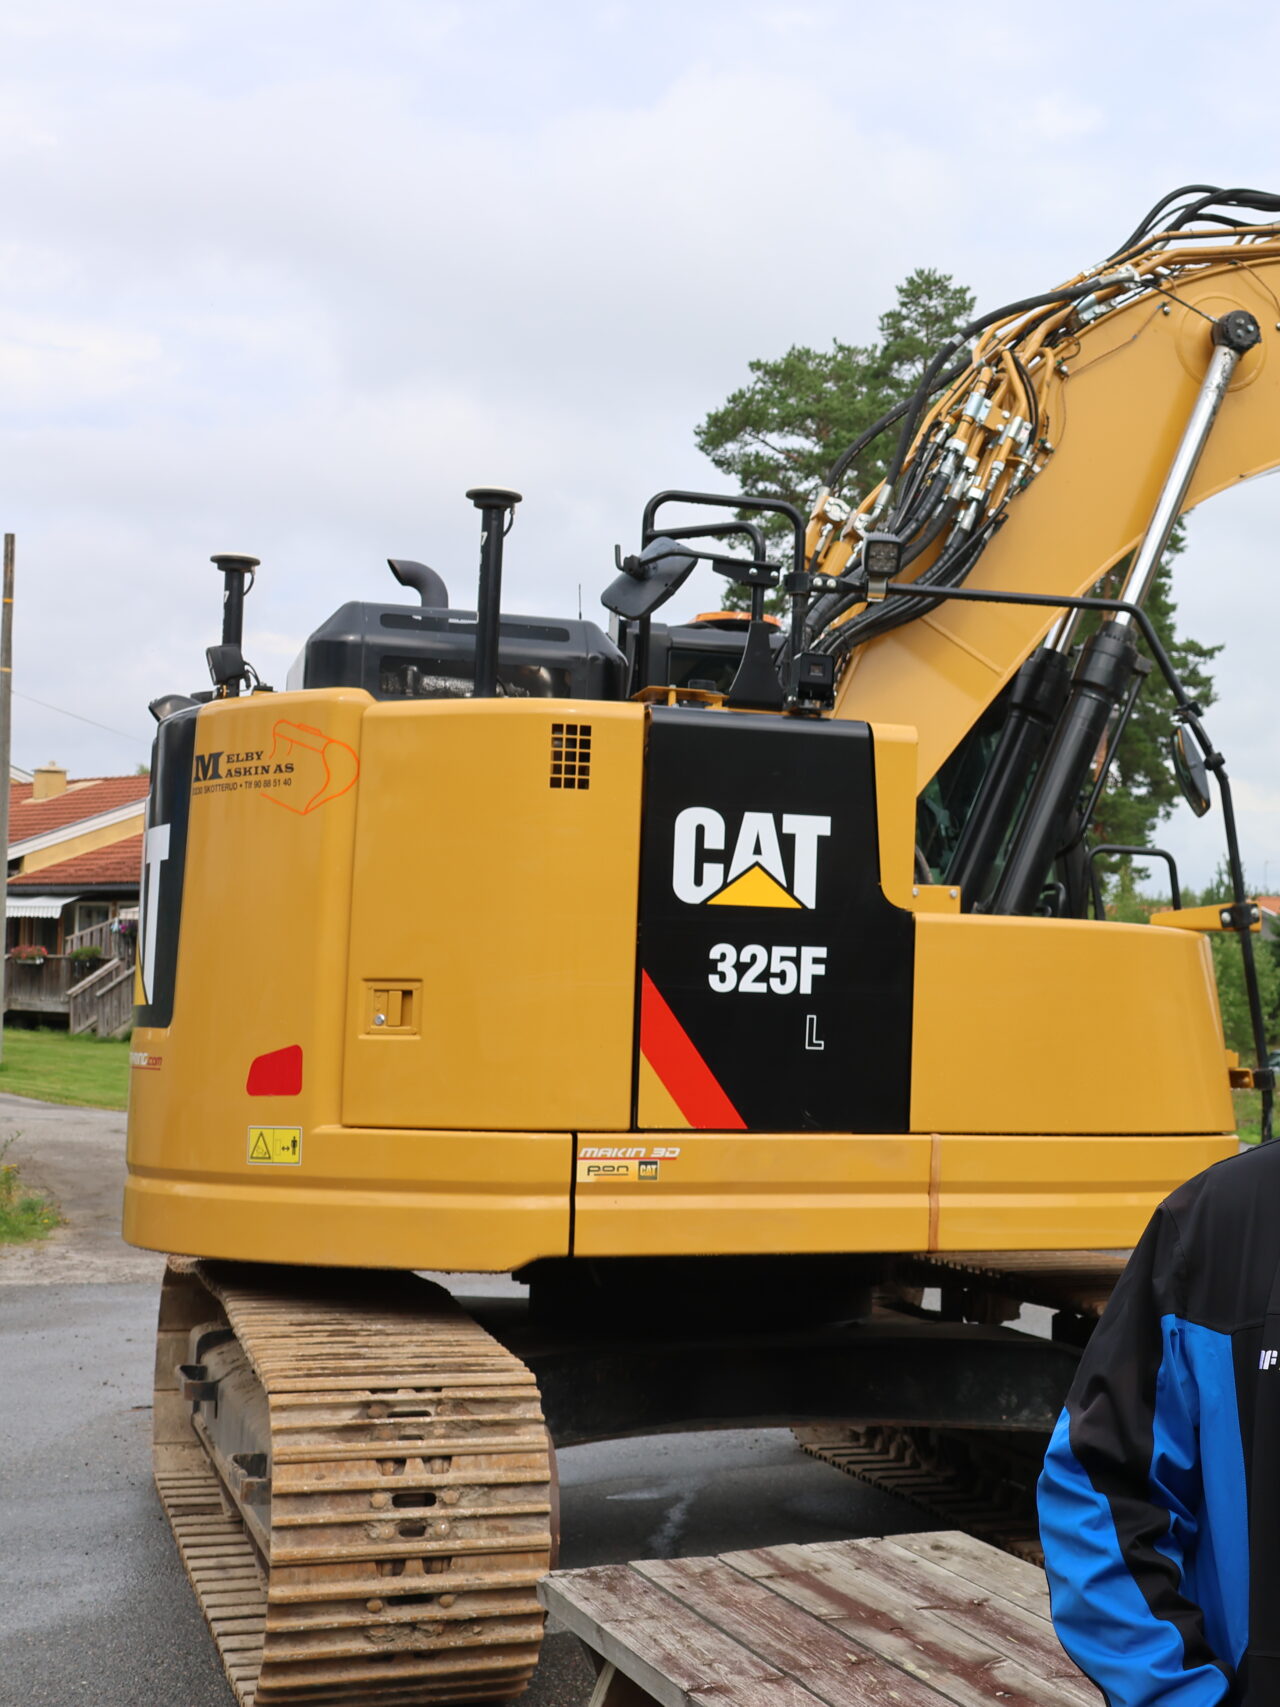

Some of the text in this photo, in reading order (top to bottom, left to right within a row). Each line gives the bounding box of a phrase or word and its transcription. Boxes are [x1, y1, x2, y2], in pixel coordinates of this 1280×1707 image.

[273, 763, 295, 774] AS
[254, 779, 262, 788] 90
[273, 778, 281, 788] 51
[283, 777, 292, 787] 40
[672, 806, 831, 910] CAT
[708, 943, 827, 995] 325F
[805, 1014, 825, 1051] L
[651, 1147, 681, 1158] 3D
[587, 1164, 657, 1177] pon CAT
